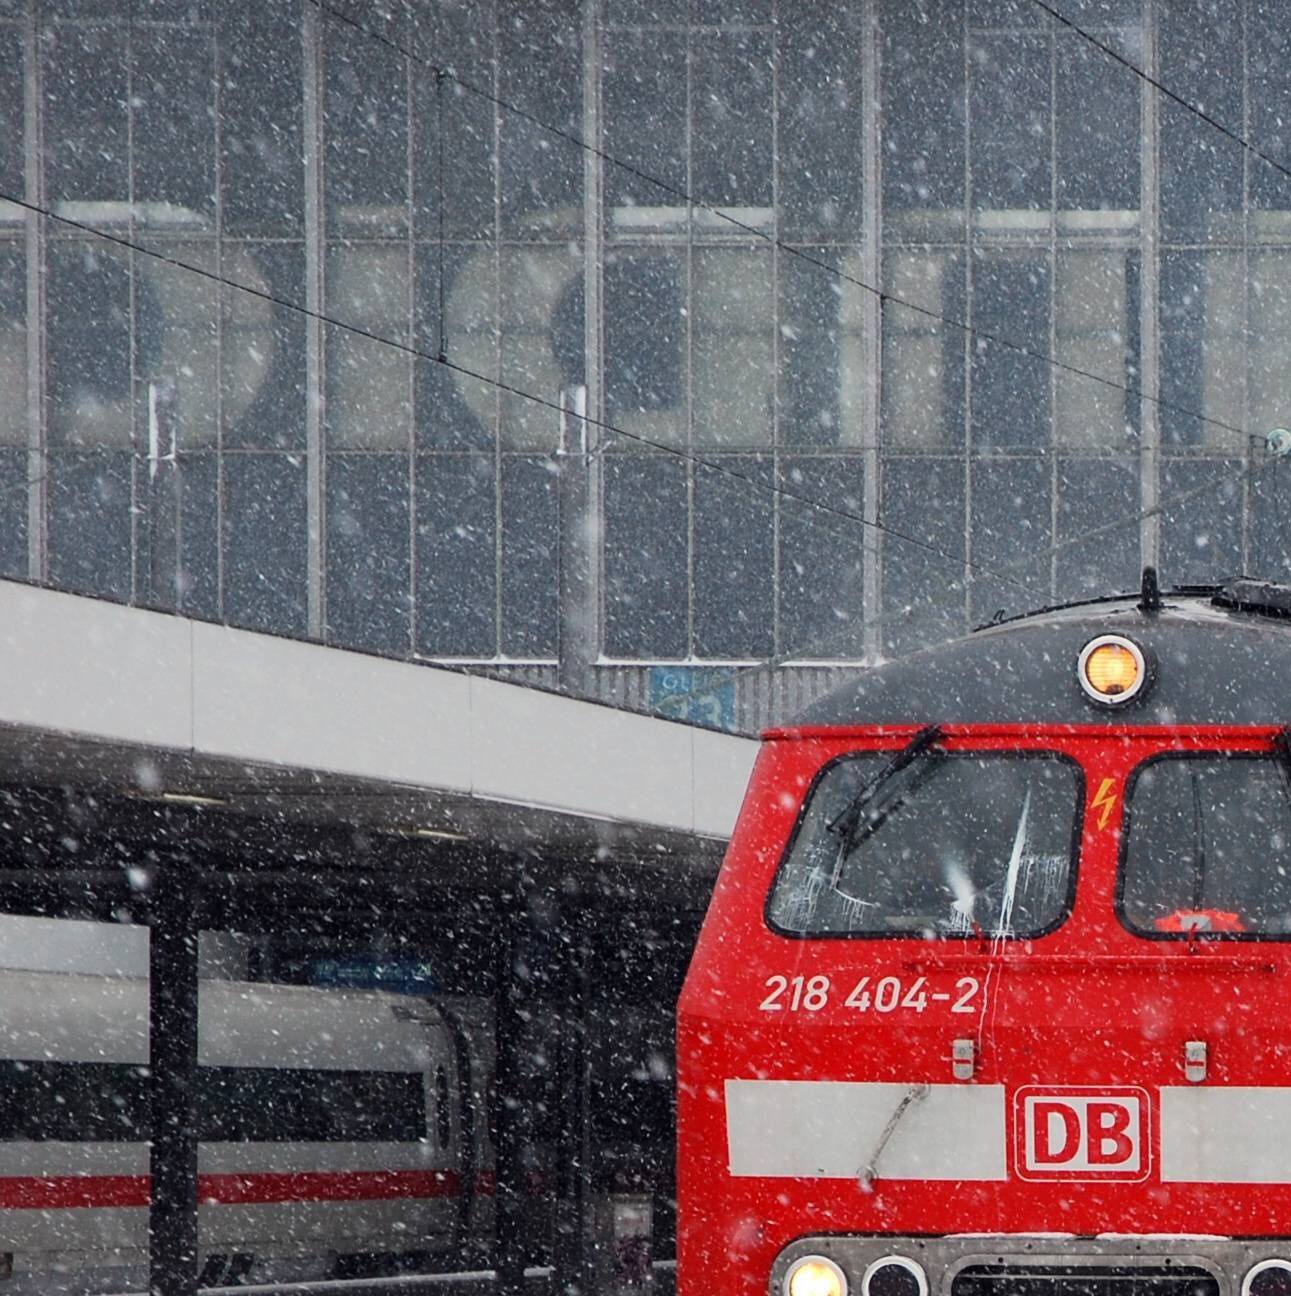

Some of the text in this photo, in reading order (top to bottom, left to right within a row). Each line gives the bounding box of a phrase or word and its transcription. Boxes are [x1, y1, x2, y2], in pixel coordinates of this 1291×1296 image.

[759, 975, 979, 1013] 218 404-2
[1033, 1102, 1134, 1165] DB
